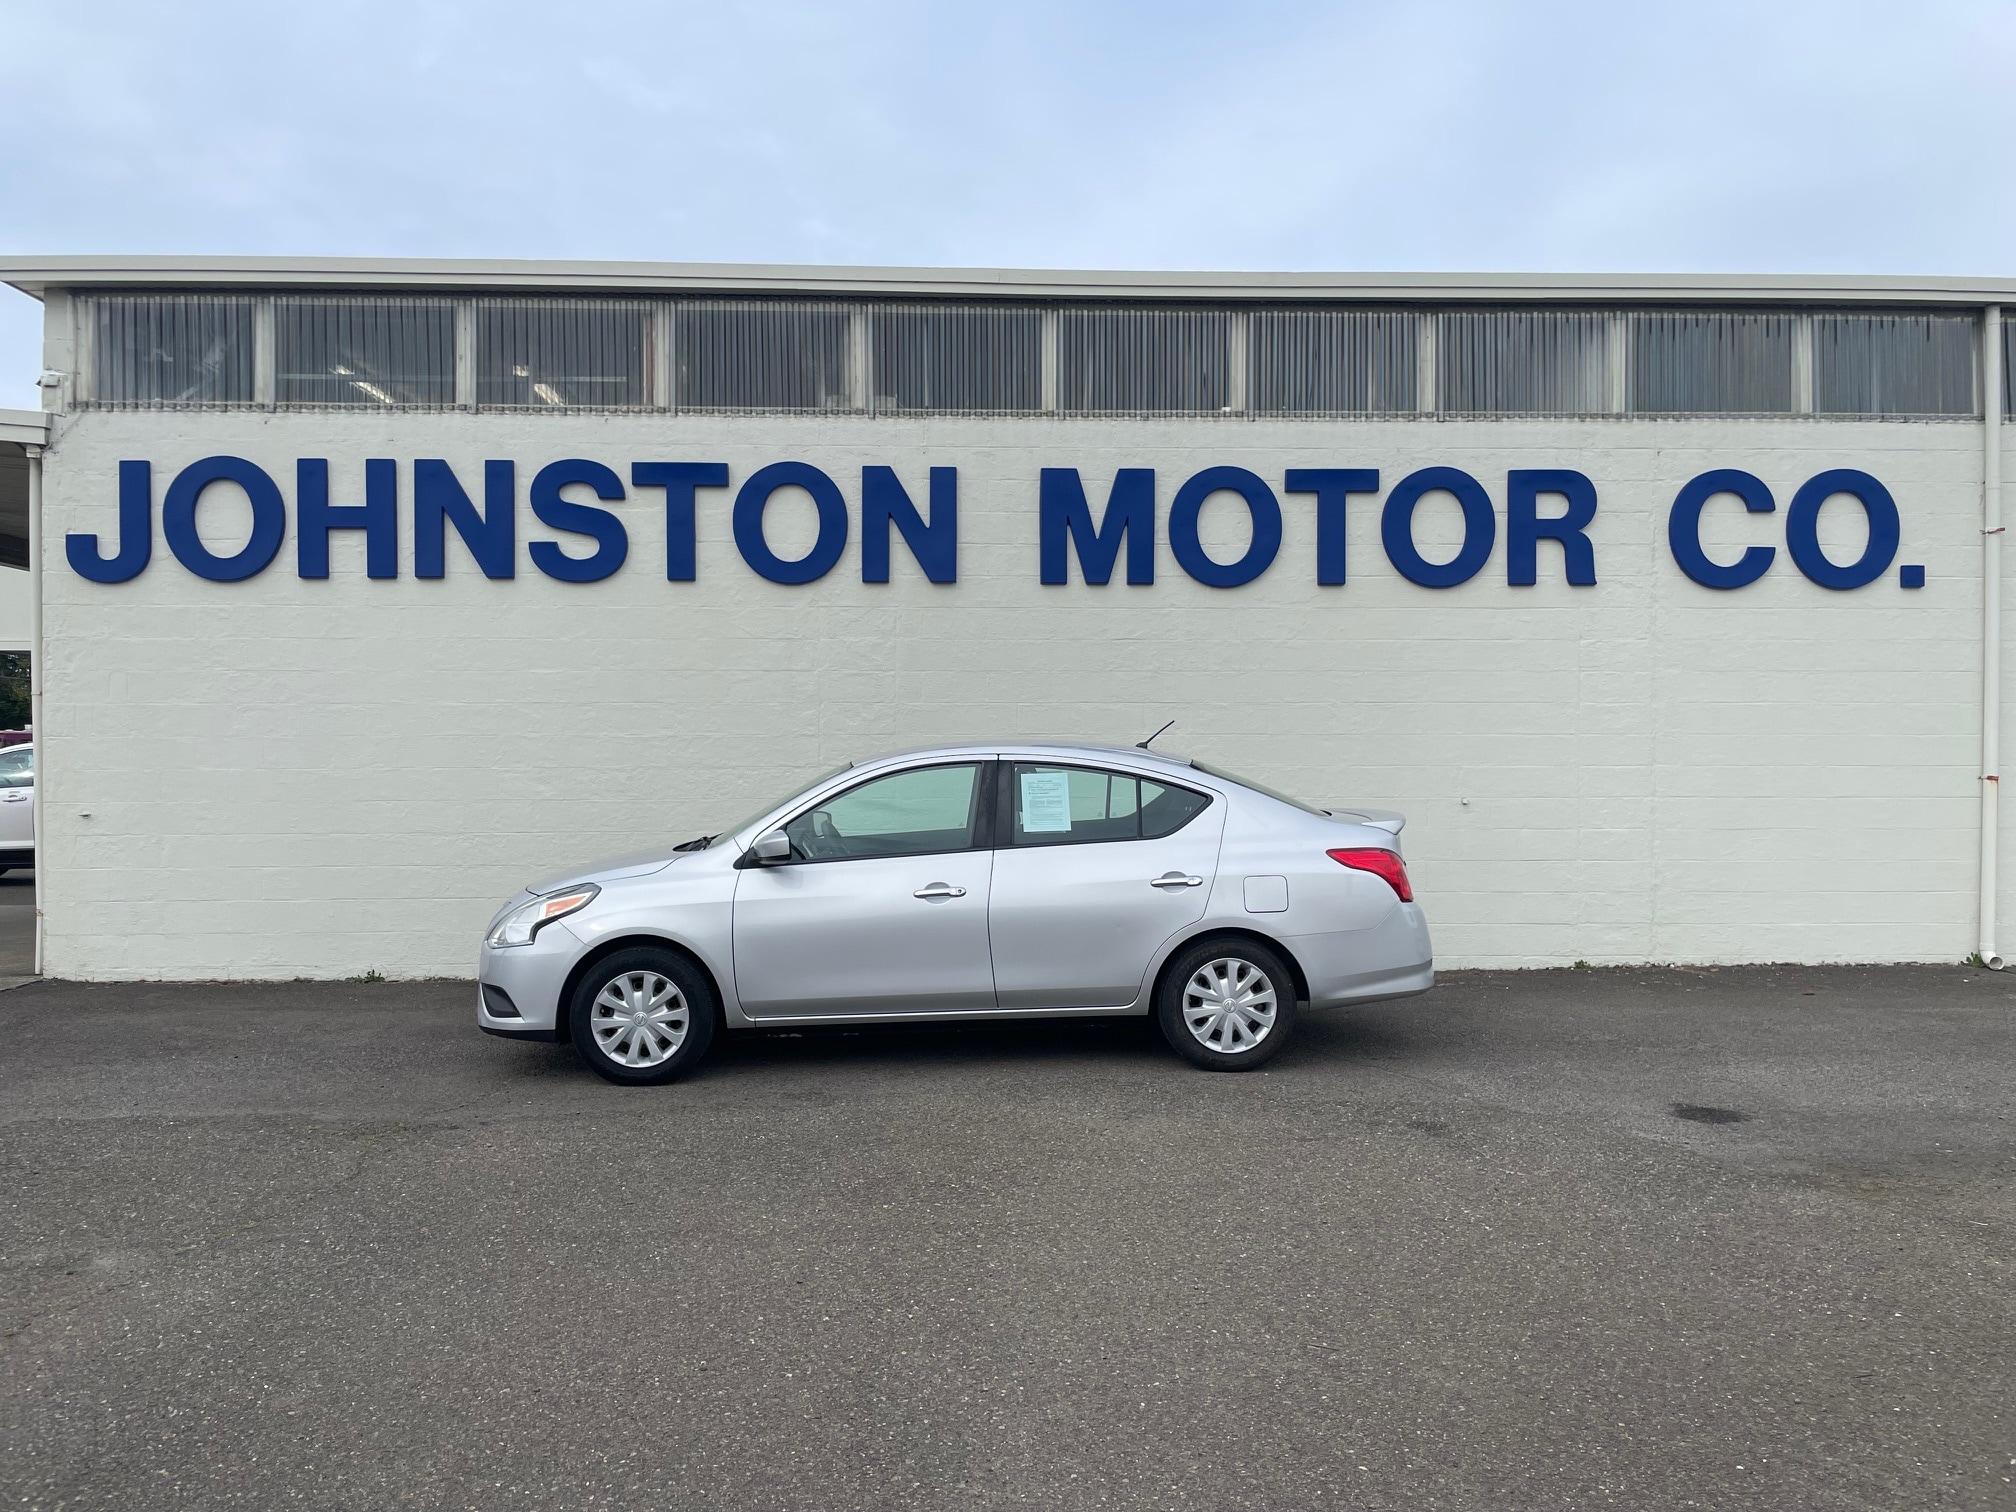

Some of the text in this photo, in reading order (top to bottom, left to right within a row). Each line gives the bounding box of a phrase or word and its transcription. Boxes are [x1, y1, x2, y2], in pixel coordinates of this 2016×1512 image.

[66, 456, 1926, 590] JOHNSTON MOTOR CO.
